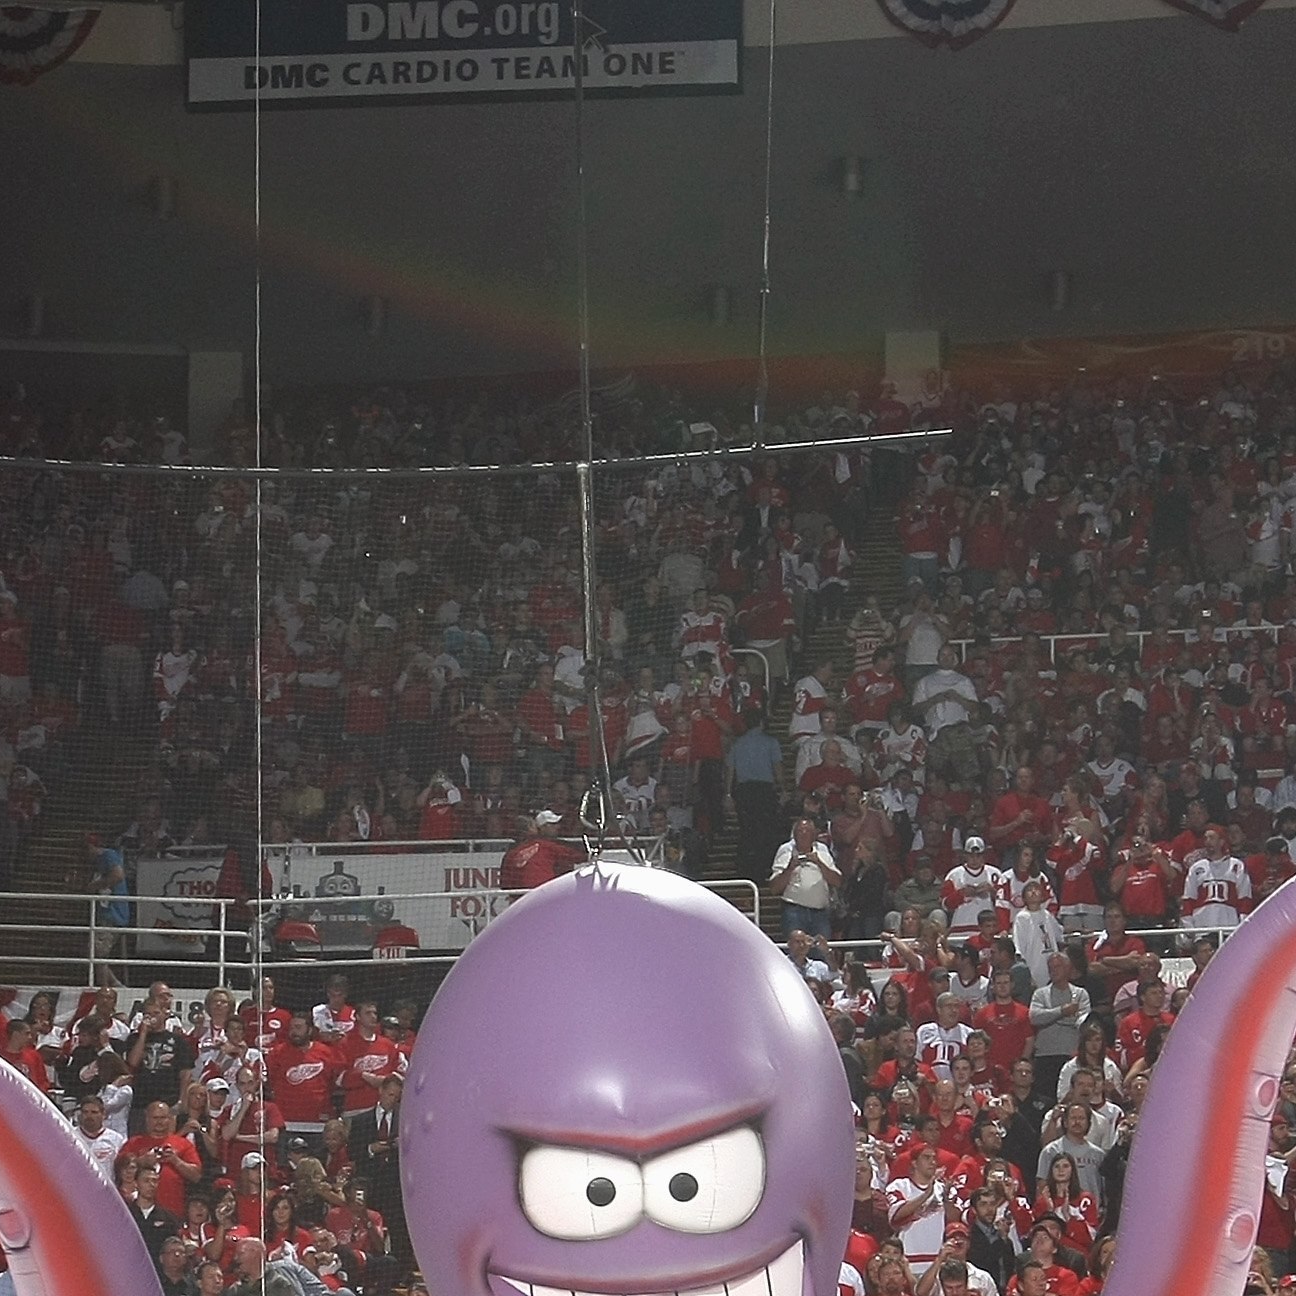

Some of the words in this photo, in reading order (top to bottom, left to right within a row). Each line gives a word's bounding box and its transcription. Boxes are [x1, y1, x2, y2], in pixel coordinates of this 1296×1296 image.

[346, 1, 559, 44] DMC.org
[244, 63, 329, 90] DMC
[342, 59, 480, 85] CARDIO
[493, 55, 589, 81] TEAM
[604, 51, 676, 76] ONE
